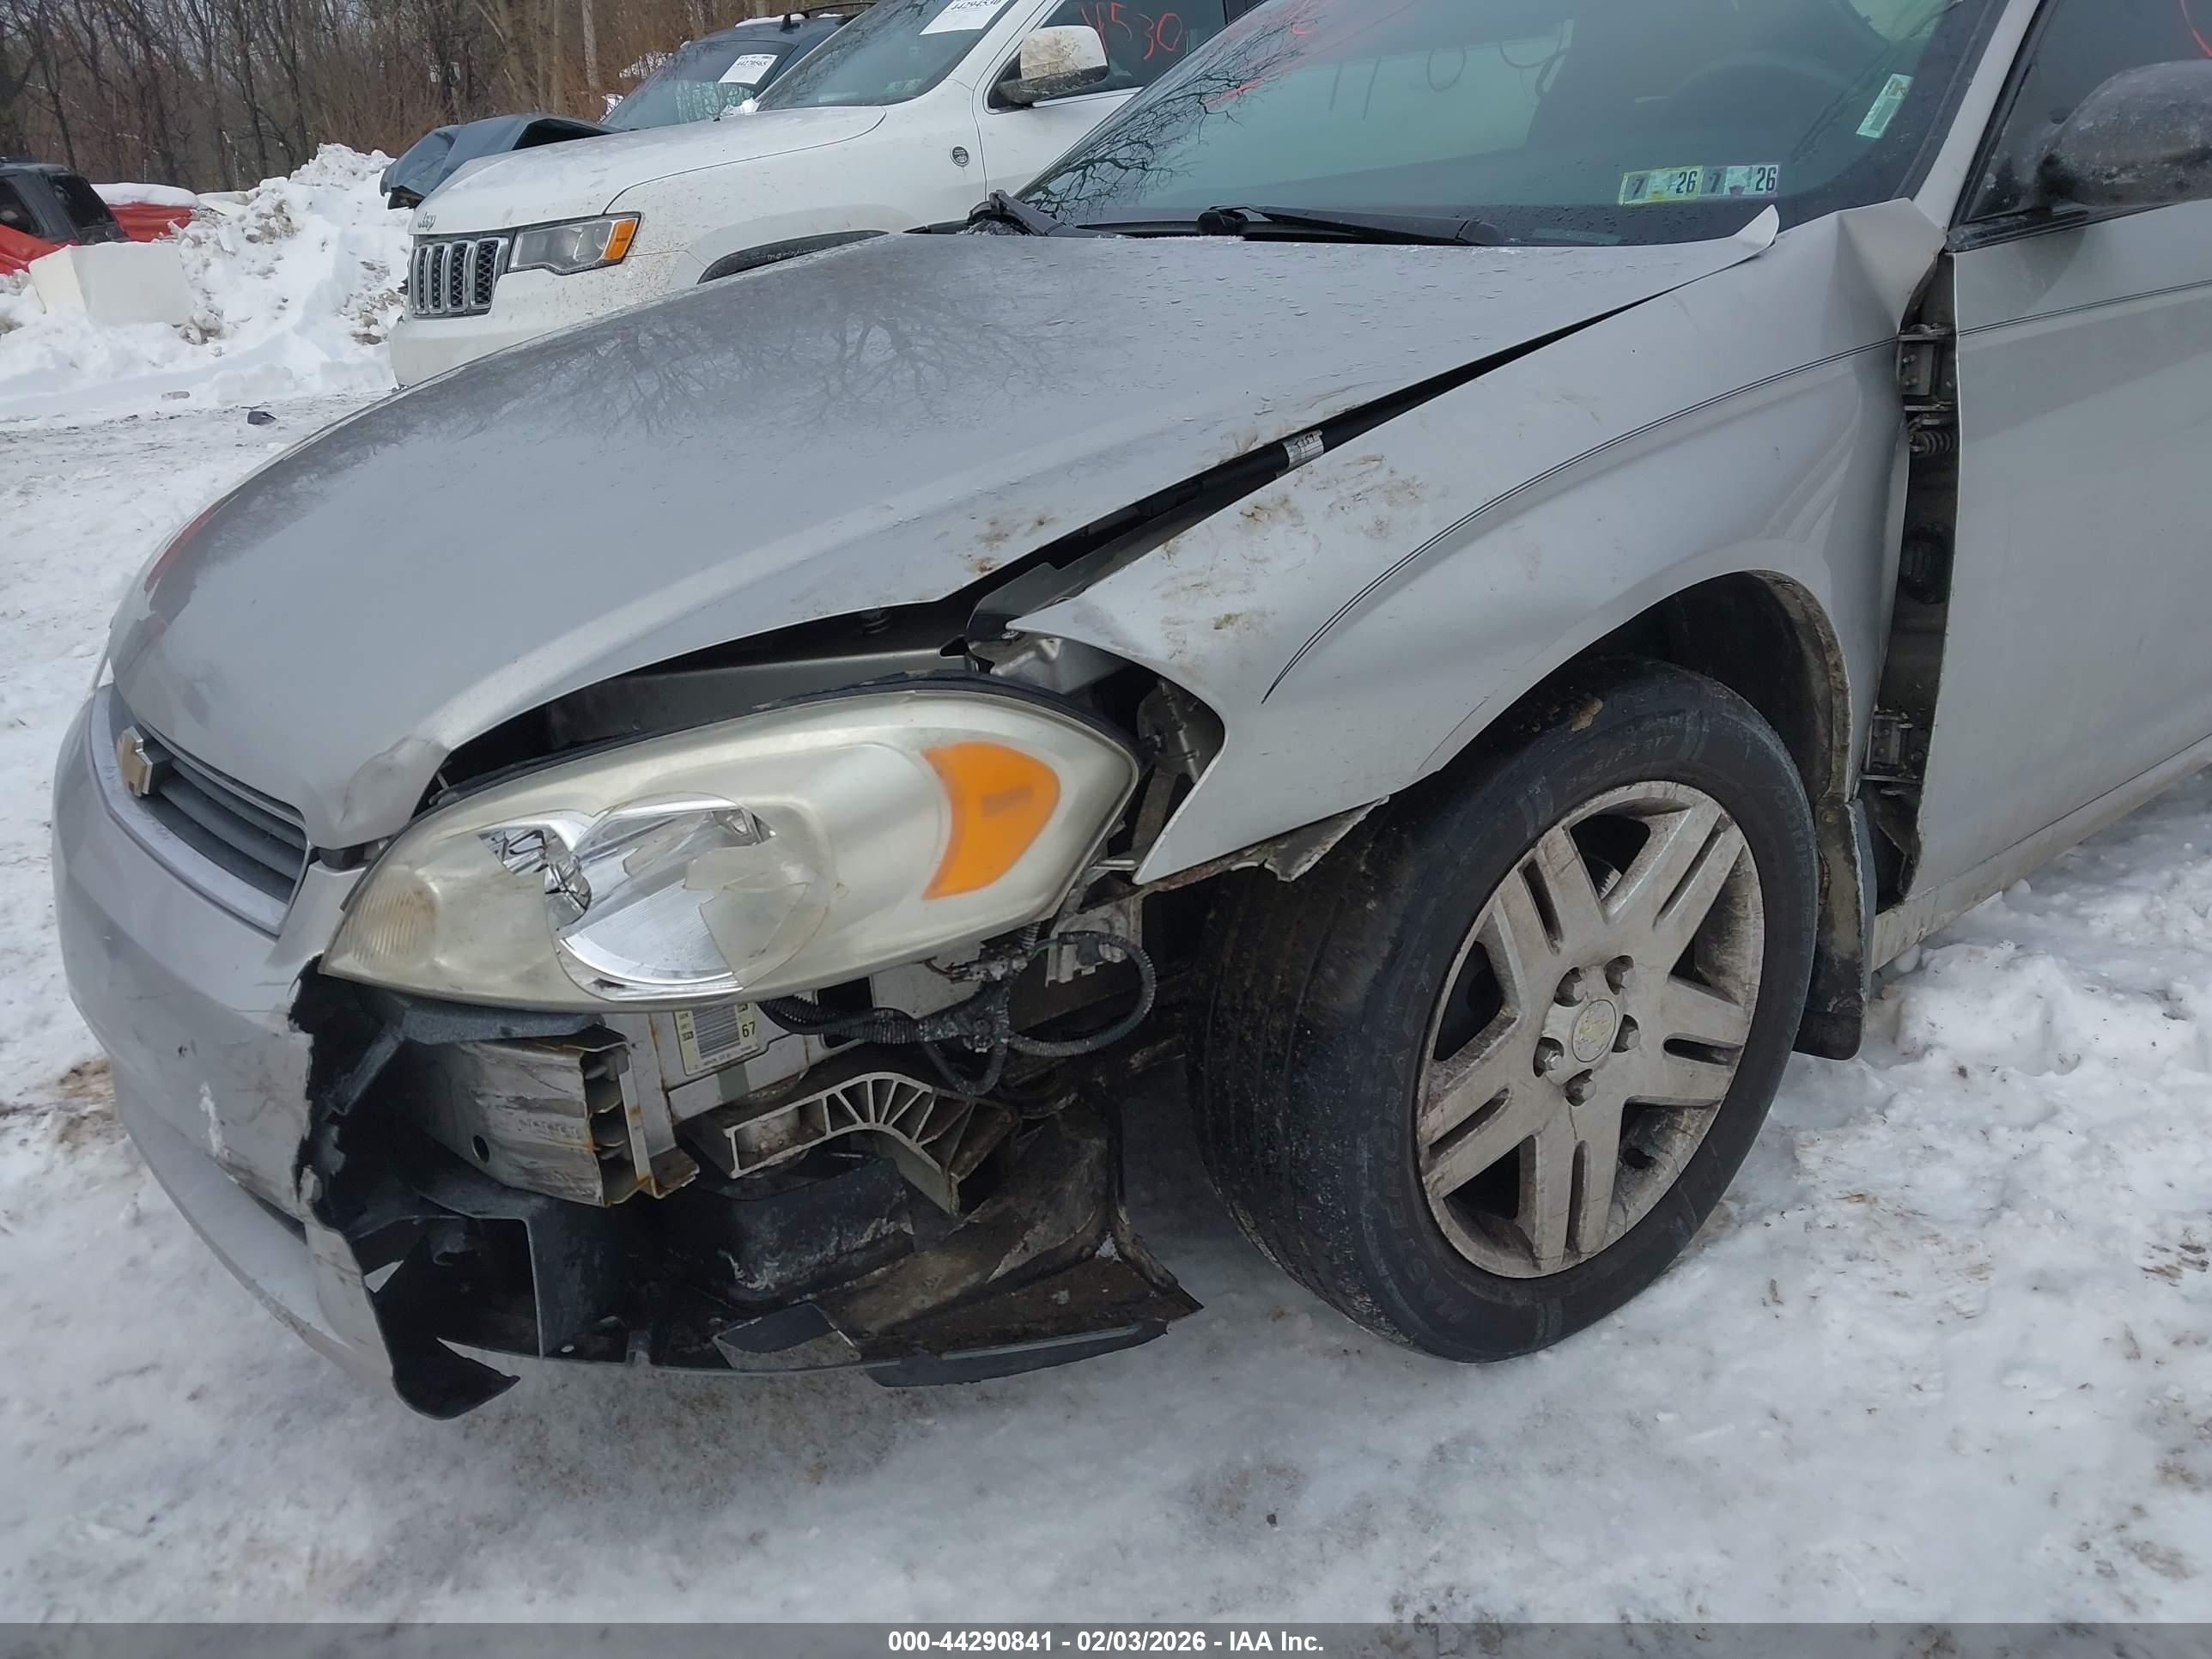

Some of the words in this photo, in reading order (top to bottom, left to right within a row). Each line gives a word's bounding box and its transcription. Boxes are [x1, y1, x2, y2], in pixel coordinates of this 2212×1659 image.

[1633, 179, 1644, 196] 7
[1676, 170, 1698, 194] 26
[1710, 173, 1722, 194] 7
[1755, 167, 1778, 192] 26
[742, 1020, 756, 1038] 67
